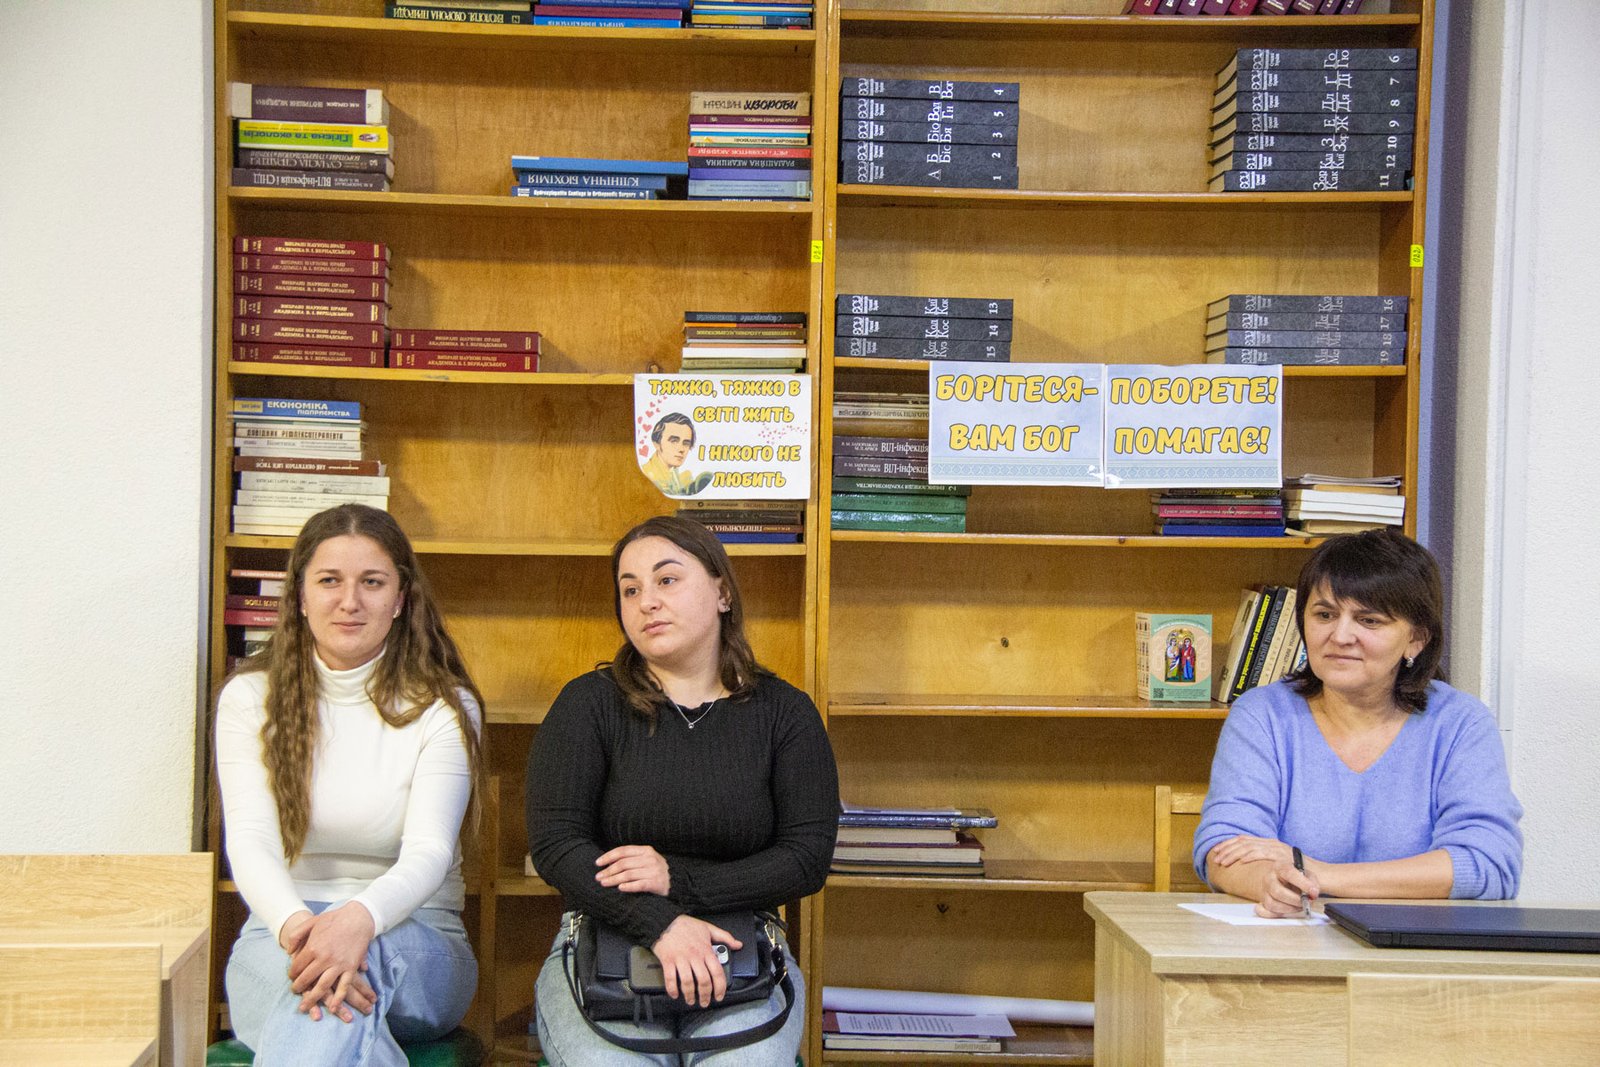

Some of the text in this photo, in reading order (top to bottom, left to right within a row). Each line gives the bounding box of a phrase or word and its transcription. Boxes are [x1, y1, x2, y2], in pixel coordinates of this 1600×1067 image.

[1389, 55, 1400, 63] 6
[994, 88, 1004, 96] 4
[1390, 99, 1400, 107] 8
[311, 133, 349, 142] Гігієна
[1388, 136, 1397, 149] 10
[706, 159, 747, 167] МЕДИЦИНА
[1386, 154, 1396, 168] 12
[253, 173, 275, 184] СНІД
[528, 174, 639, 186] КЛІНІЧНА БІОХІМІЯ
[1379, 175, 1389, 187] 11
[989, 302, 998, 314] 13
[1384, 298, 1394, 311] 16
[1380, 317, 1389, 329] 17
[989, 325, 998, 336] 14
[1383, 333, 1392, 346] 18
[987, 346, 996, 357] 15
[1380, 350, 1388, 363] 19
[649, 379, 801, 398] ТЯЖКО, ТЯЖКО В
[936, 375, 1279, 404] БОРІТЕСЯ- ПОБОРЕТЕ!
[267, 401, 328, 409] ЕКОНОМІКА
[297, 409, 350, 417] ПІДПРИЄМСТВА
[693, 406, 794, 423] СВІТІ ЖИТЬ
[949, 424, 1271, 454] ВАМ БОГ ПОМАГАЄ!
[698, 445, 801, 461] І НІКОГО НЕ
[713, 471, 786, 487] ЛЮБИТЬ
